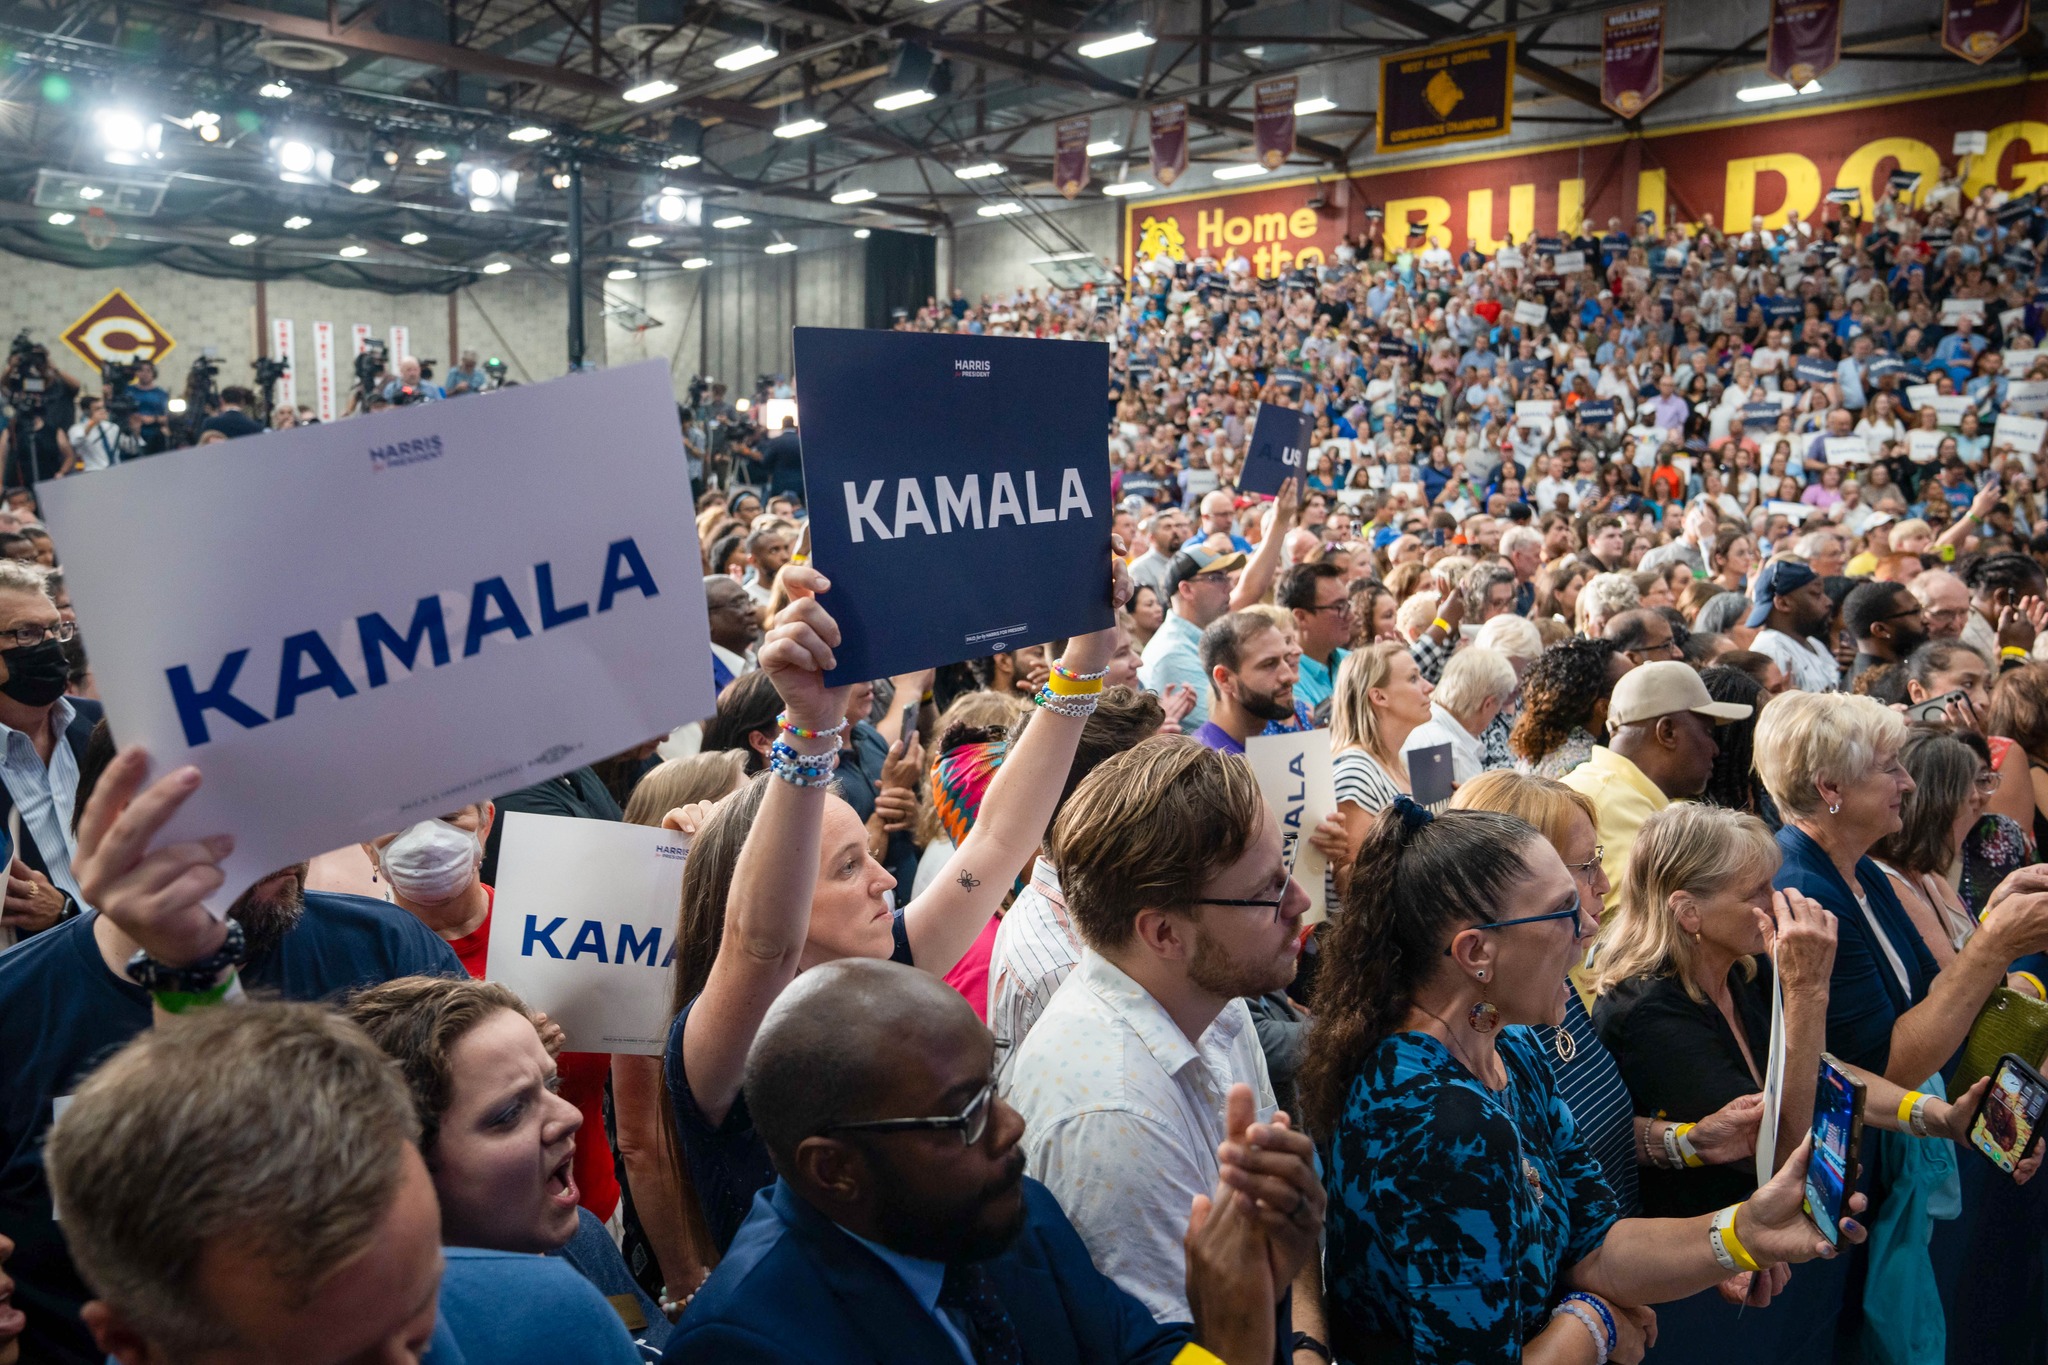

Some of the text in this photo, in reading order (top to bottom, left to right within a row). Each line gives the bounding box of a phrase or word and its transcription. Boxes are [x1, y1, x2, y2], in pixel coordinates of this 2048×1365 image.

[1198, 208, 1318, 249] Home
[955, 360, 990, 370] HARRIS
[369, 434, 443, 461] HARRIS
[387, 451, 442, 468] PRESIDENT
[843, 468, 1093, 543] KAMALA
[165, 536, 660, 747] KAMALA
